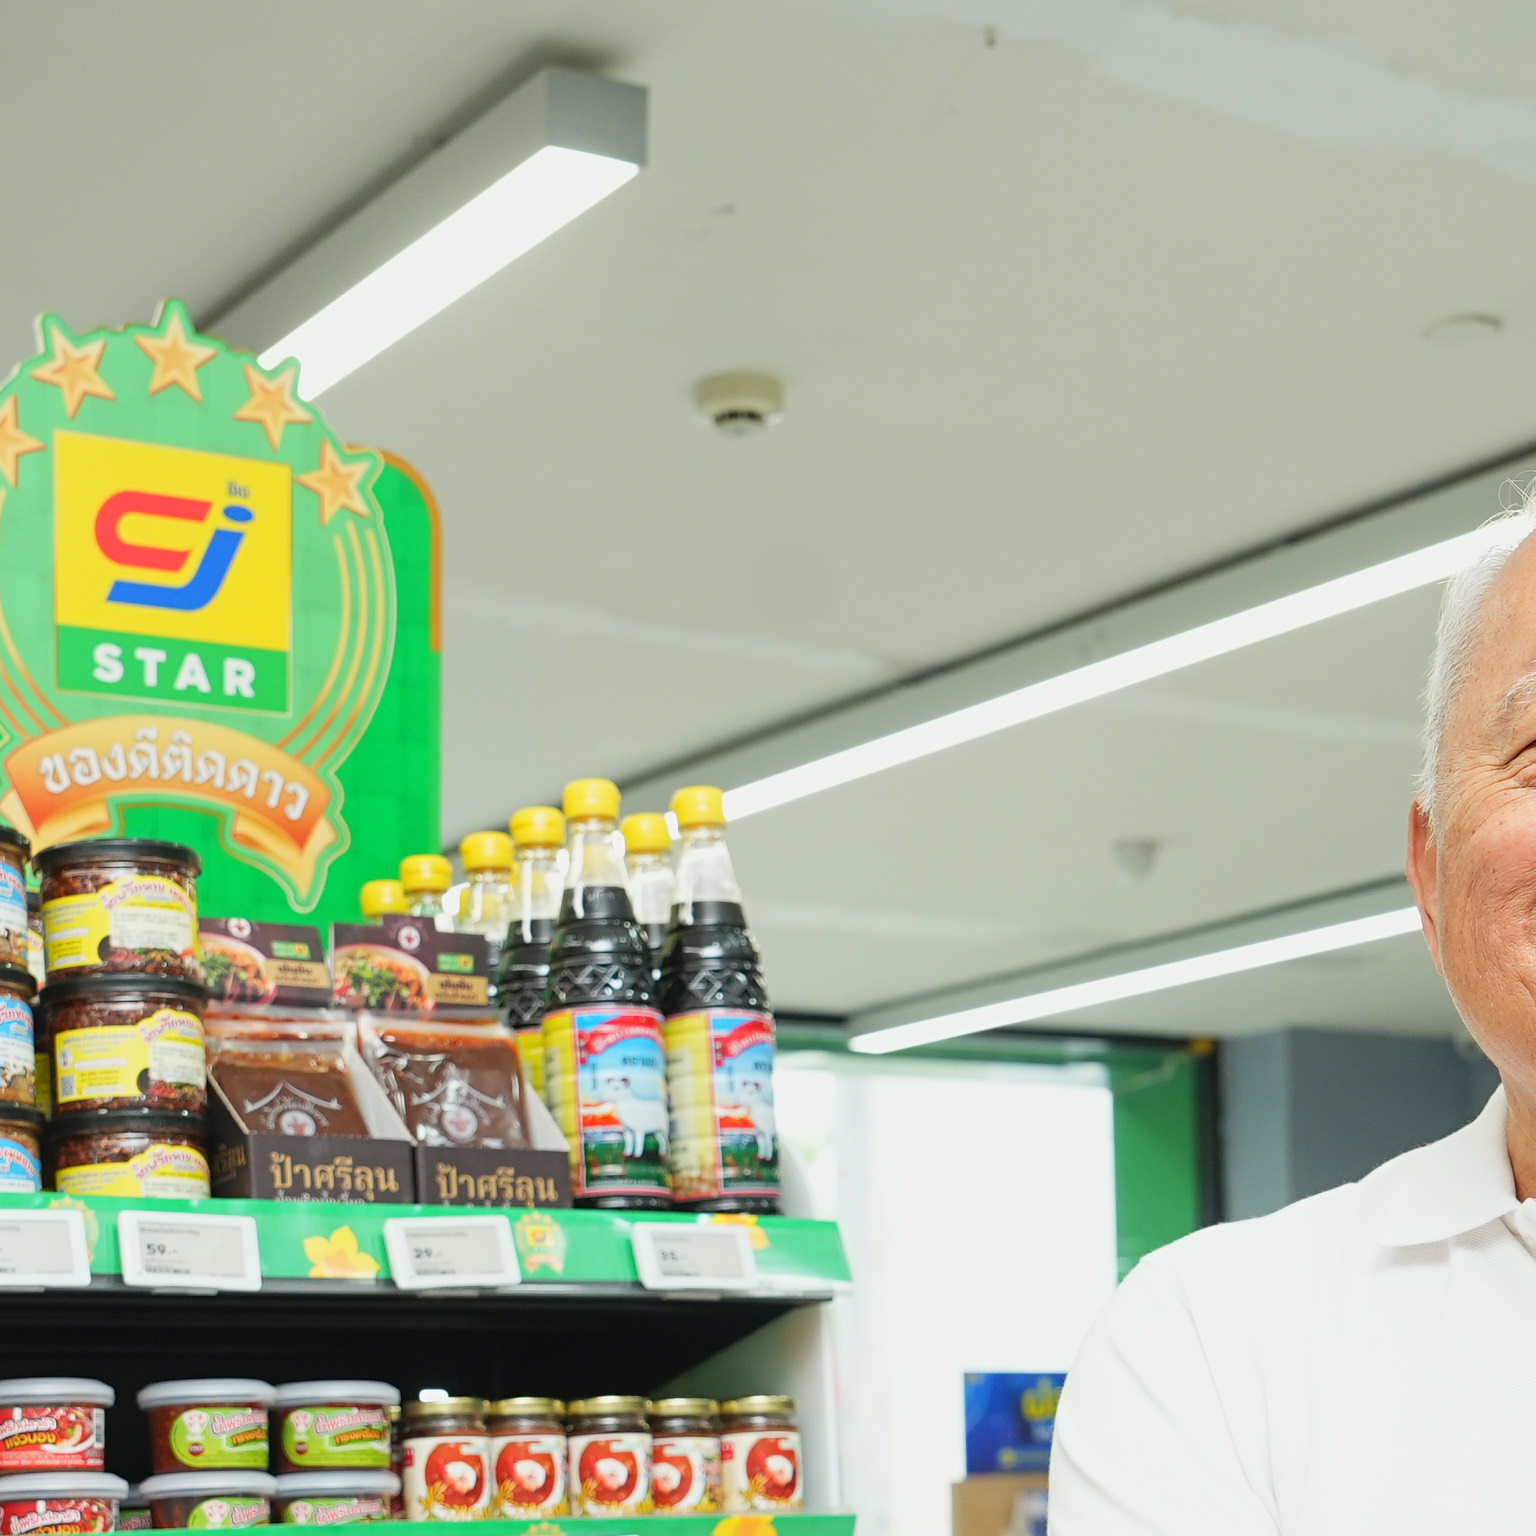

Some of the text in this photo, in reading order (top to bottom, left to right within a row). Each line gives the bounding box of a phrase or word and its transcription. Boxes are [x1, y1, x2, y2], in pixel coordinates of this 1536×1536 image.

[92, 641, 257, 699] STAR
[39, 725, 312, 822] ของดีติดดาว
[270, 1151, 400, 1201] ป้าศรีลุน
[436, 1162, 559, 1208] ป้าศรีลุน
